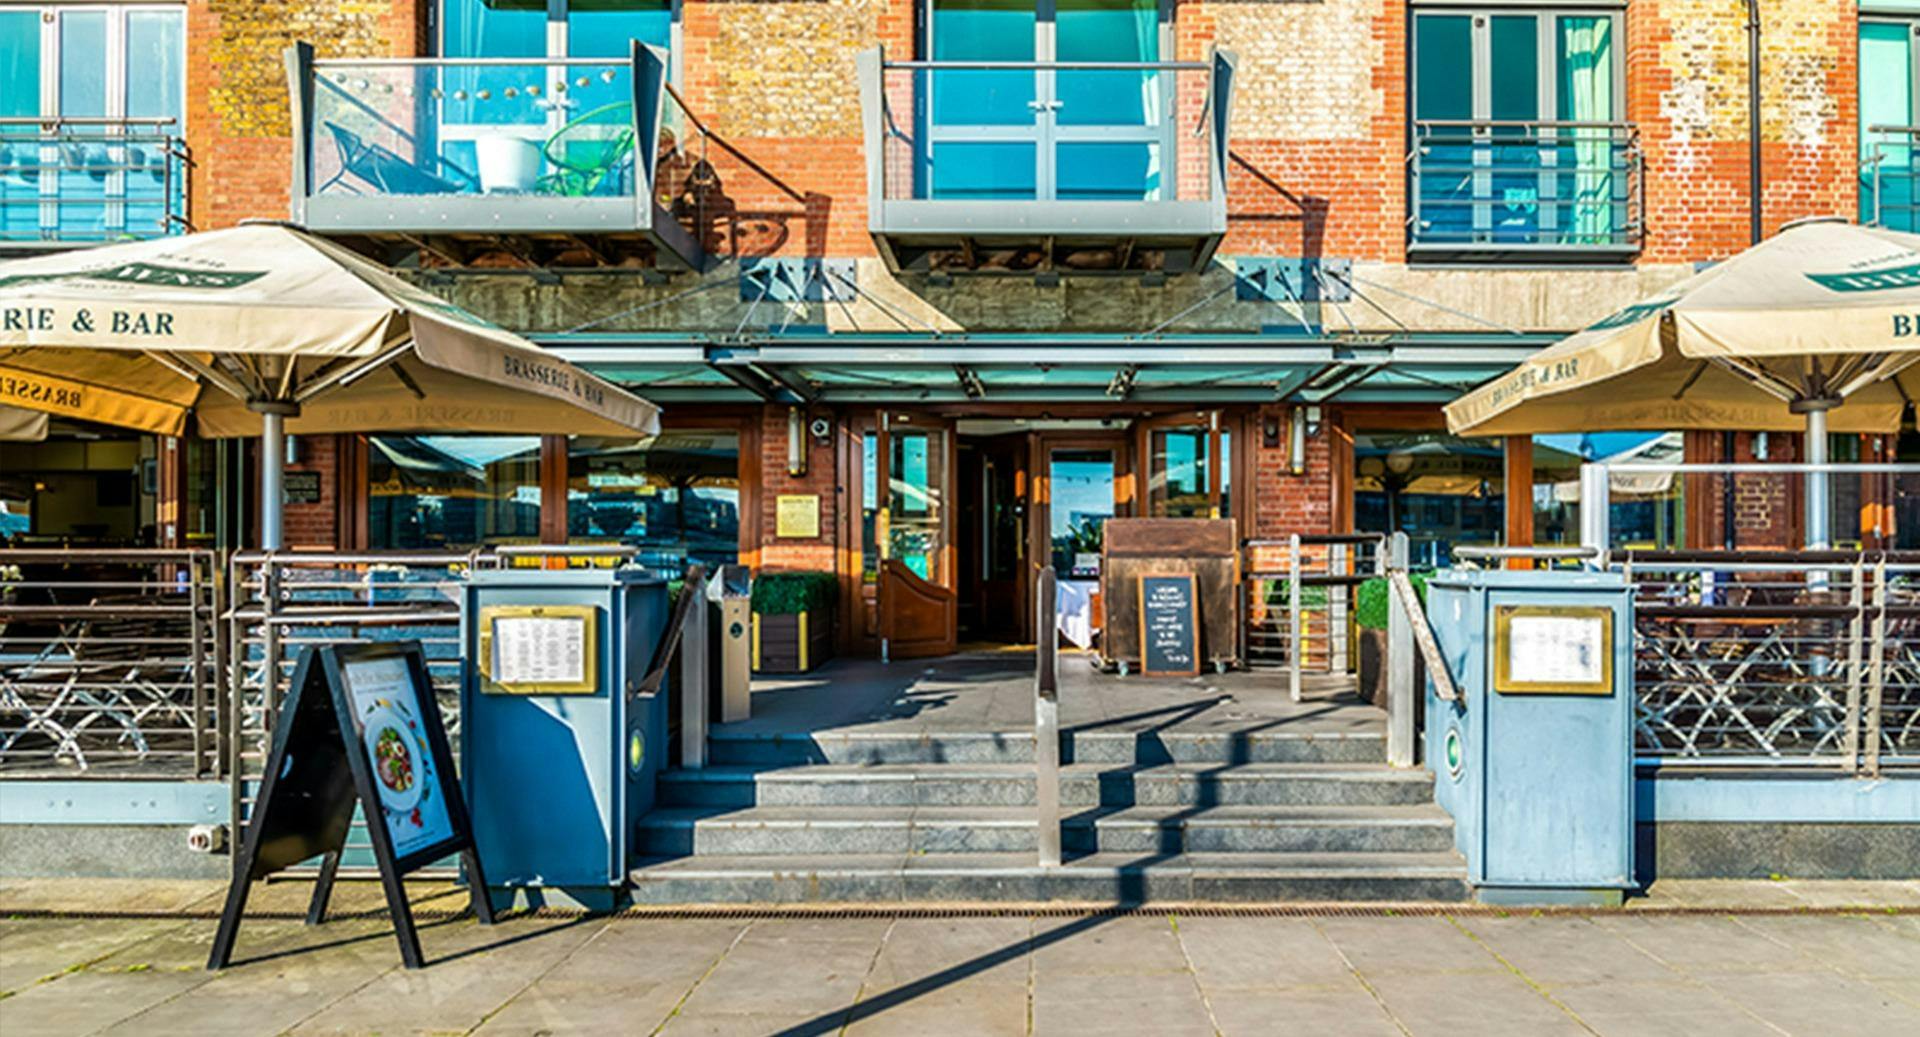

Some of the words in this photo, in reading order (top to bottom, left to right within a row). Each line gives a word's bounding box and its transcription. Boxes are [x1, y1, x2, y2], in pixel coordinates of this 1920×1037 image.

[72, 308, 95, 332] &
[111, 311, 174, 335] BAR
[504, 355, 569, 391] BRASSERIE
